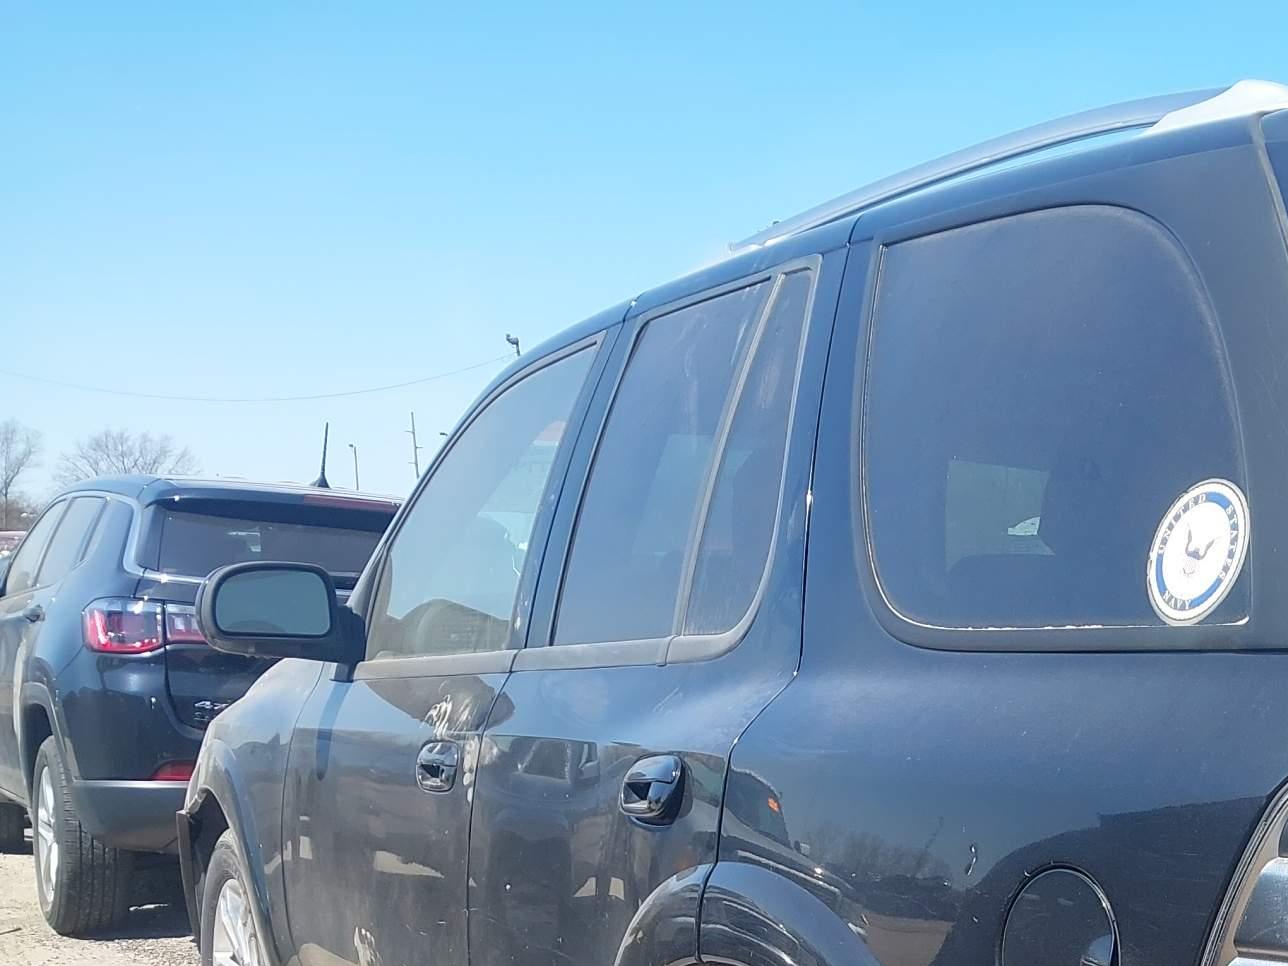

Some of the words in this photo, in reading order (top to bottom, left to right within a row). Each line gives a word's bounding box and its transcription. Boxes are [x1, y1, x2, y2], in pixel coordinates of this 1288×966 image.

[1157, 493, 1208, 555] UNITED
[1219, 503, 1240, 580] STATES
[1162, 590, 1193, 610] NAVY
